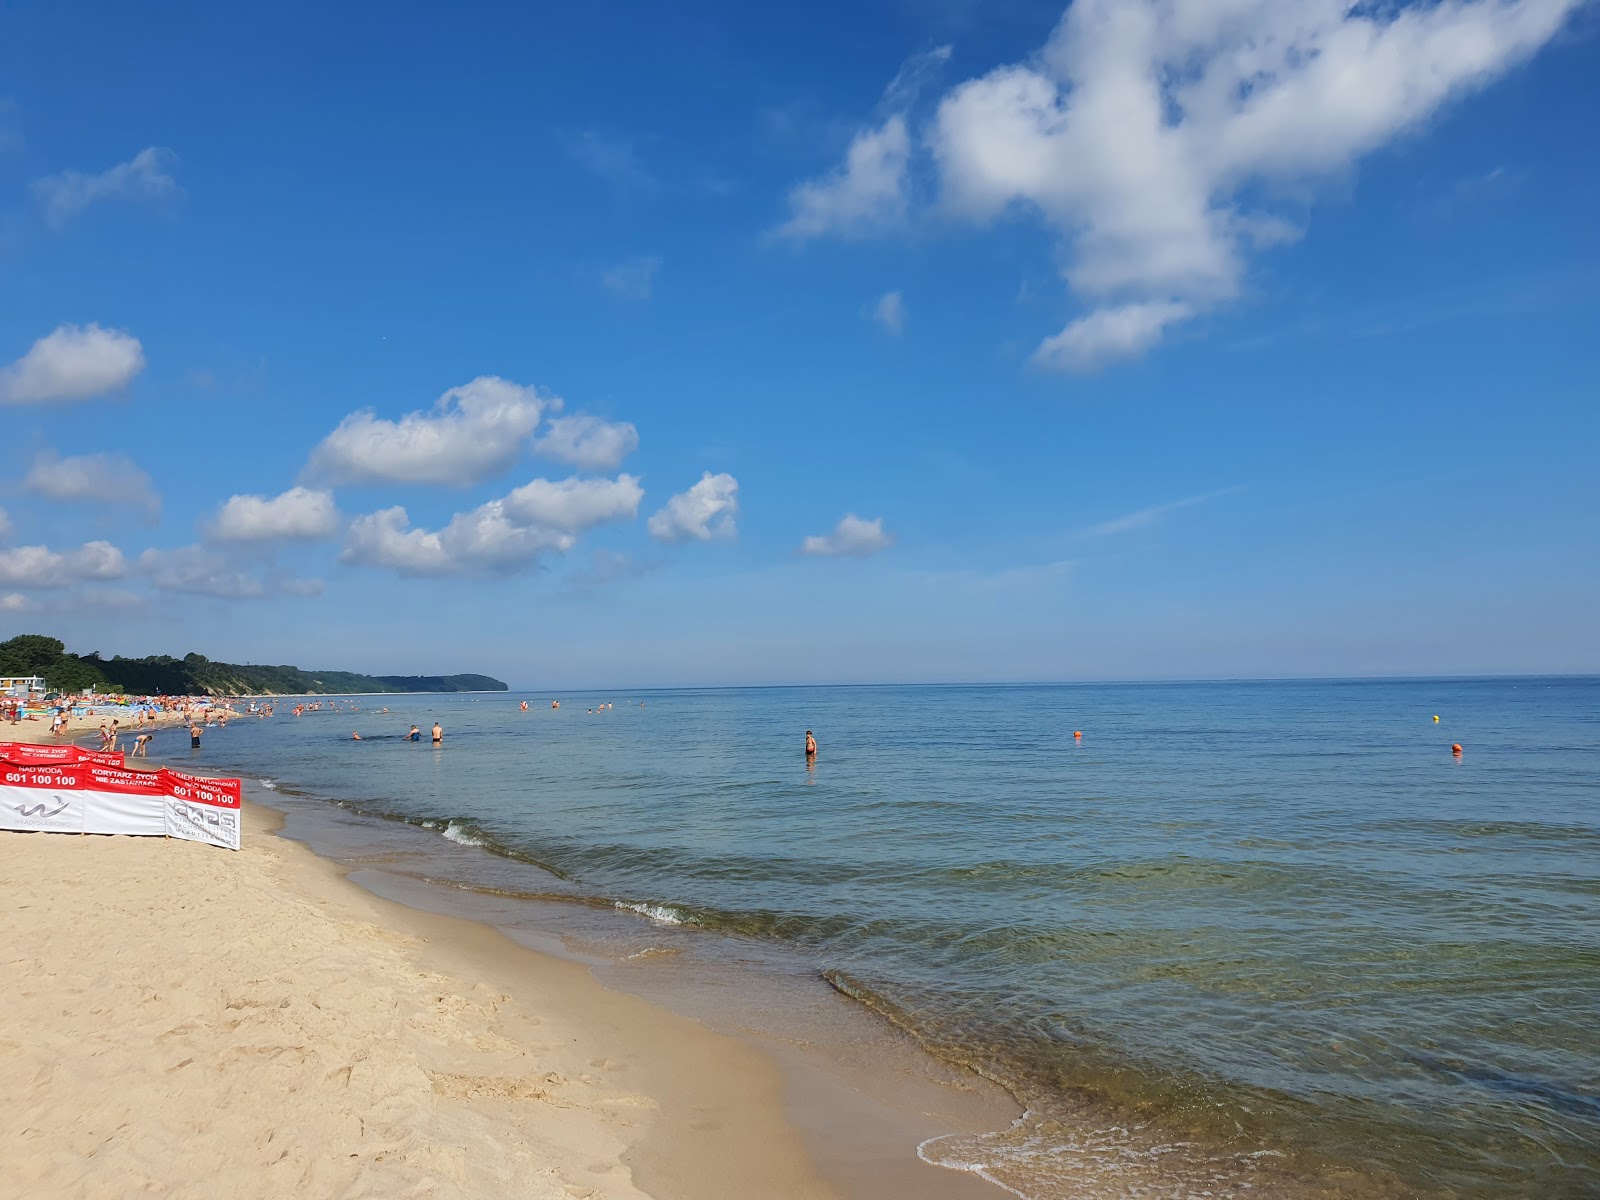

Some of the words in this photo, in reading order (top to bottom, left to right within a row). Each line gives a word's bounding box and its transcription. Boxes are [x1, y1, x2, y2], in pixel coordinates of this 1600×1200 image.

[37, 767, 63, 775] WODĄ
[91, 768, 133, 779] KORYTARZ
[136, 773, 159, 781] ŻYCIA
[6, 773, 27, 783] 601
[31, 774, 52, 785] 100
[55, 776, 76, 786] 100
[173, 785, 191, 797] 601
[195, 790, 213, 801] 100
[216, 794, 234, 804] 100
[200, 784, 223, 794] WODĄ
